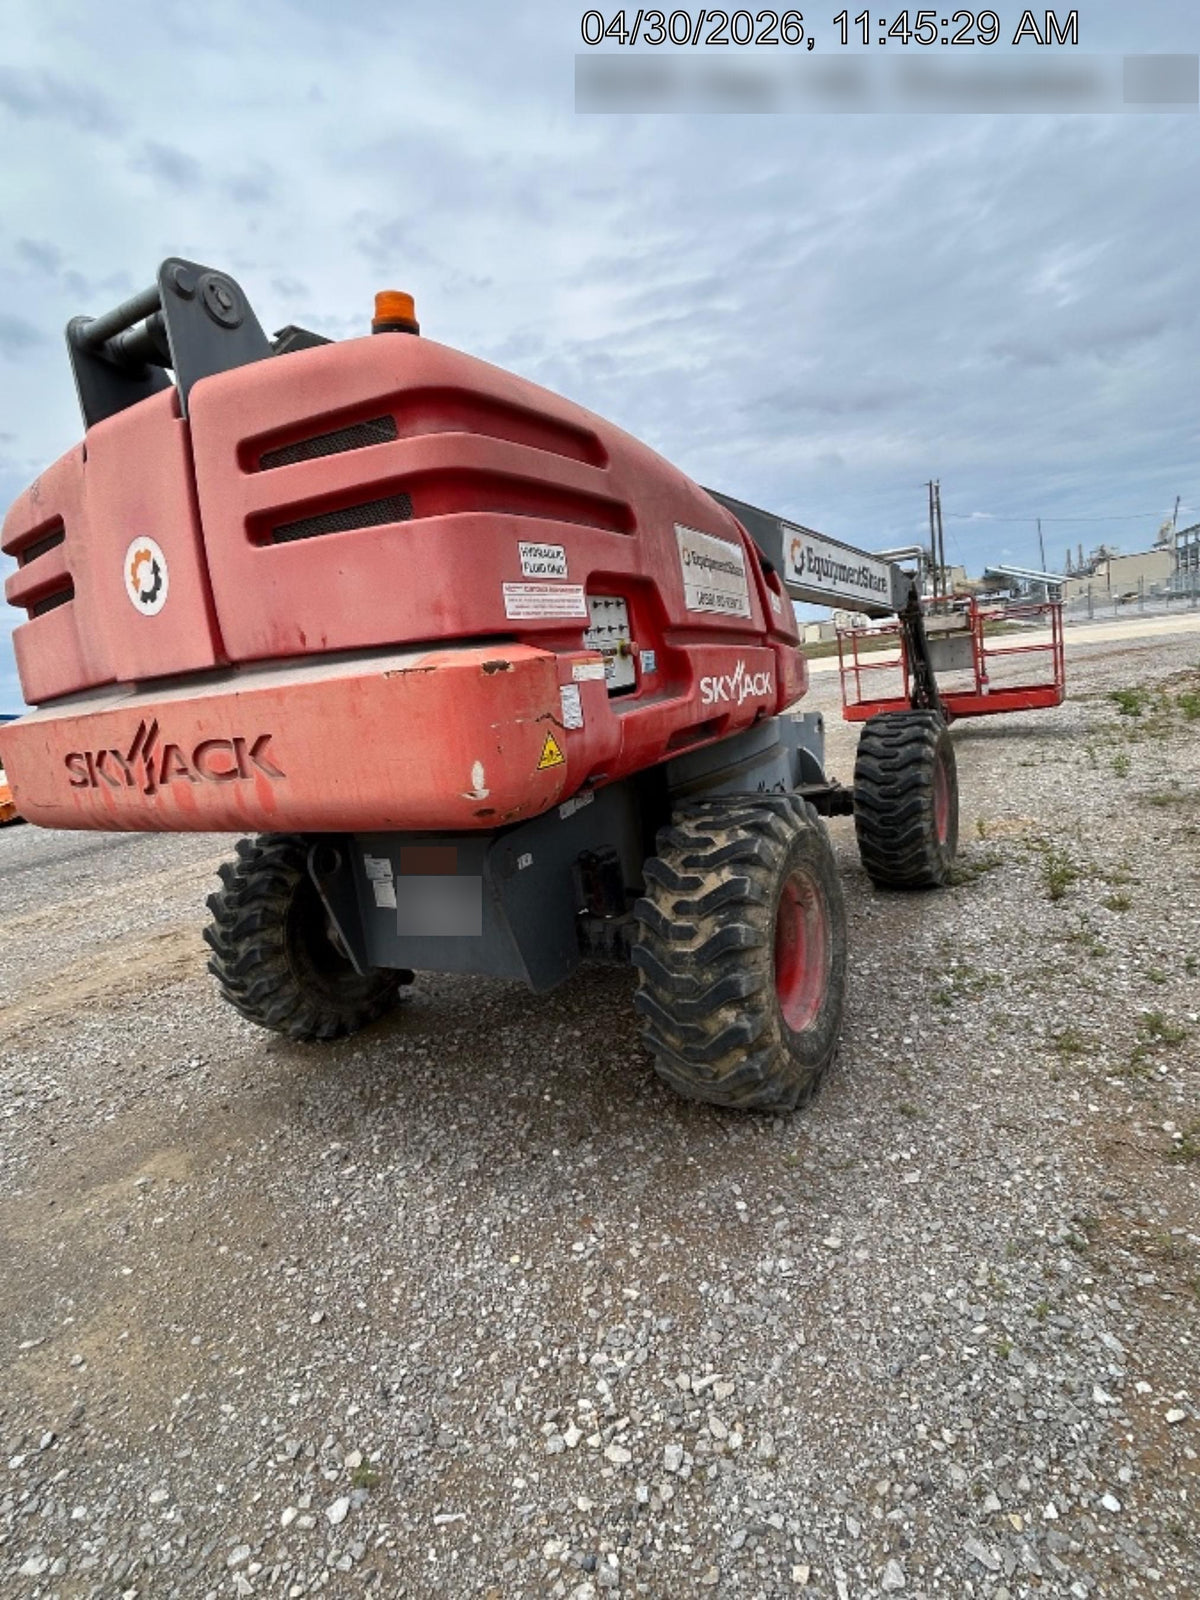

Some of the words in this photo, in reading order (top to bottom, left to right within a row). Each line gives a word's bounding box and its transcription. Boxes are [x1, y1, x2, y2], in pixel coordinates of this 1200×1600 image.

[806, 546, 888, 593] EquipmentShare
[700, 660, 773, 706] SKYJACK
[64, 718, 286, 795] SKYJACK
